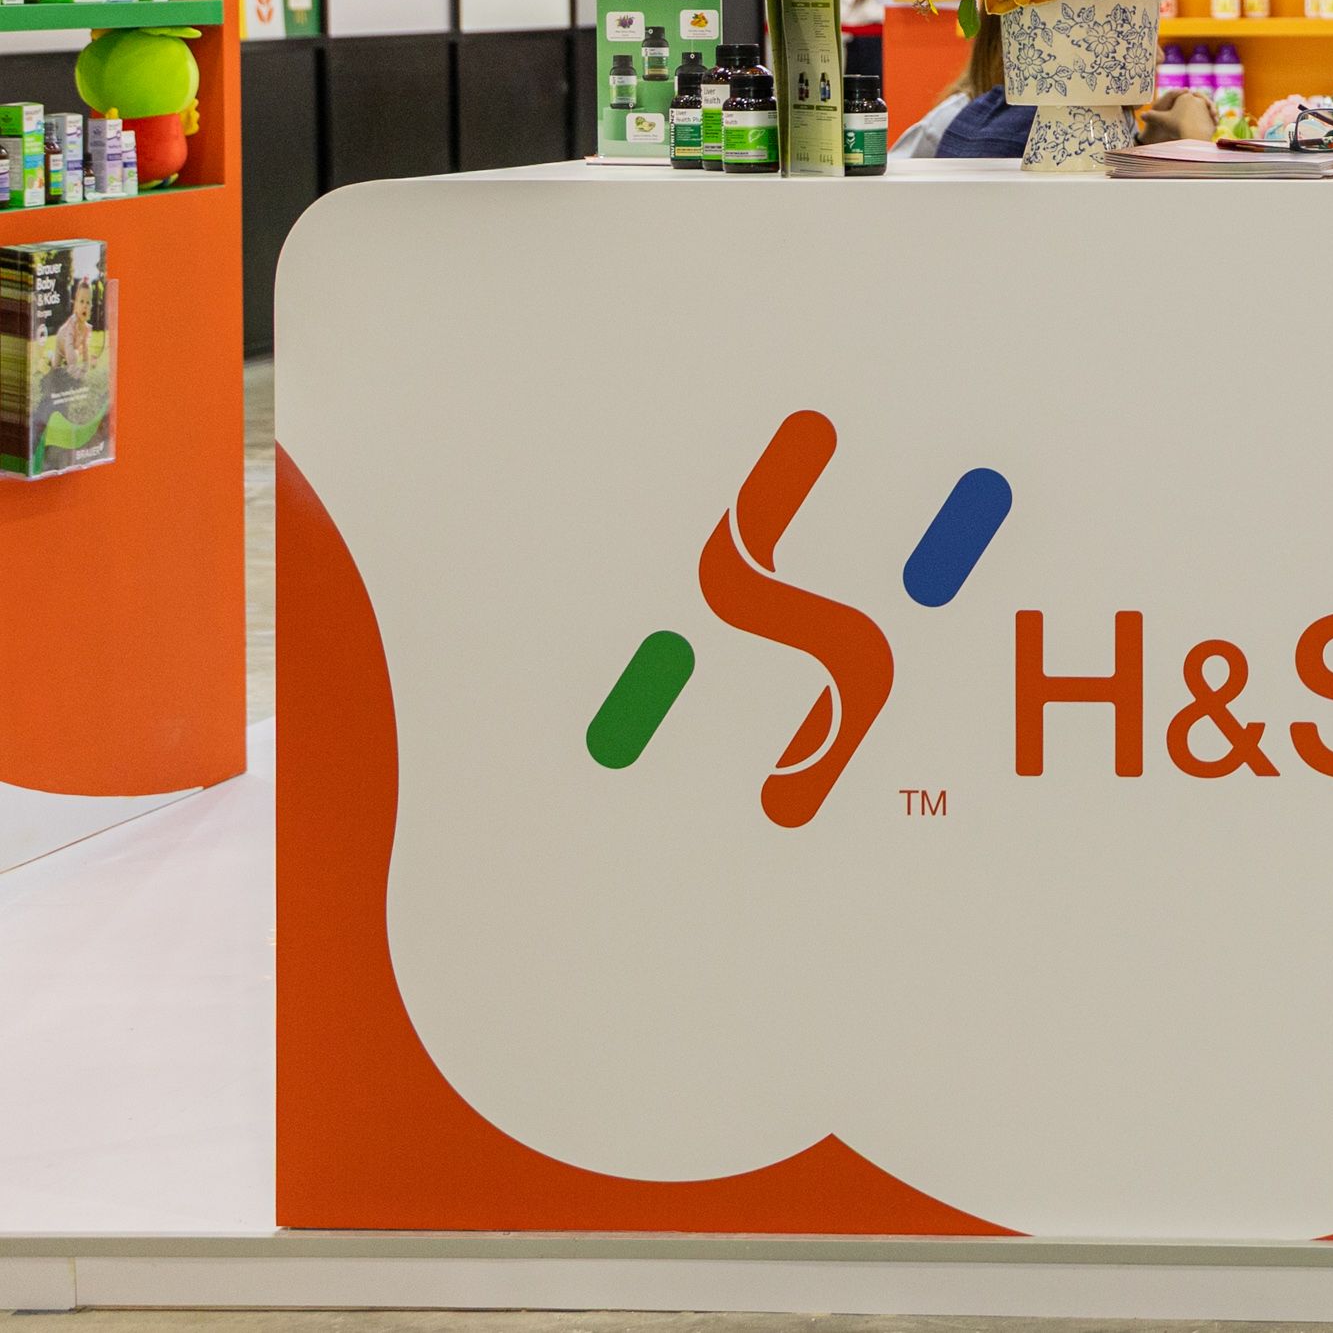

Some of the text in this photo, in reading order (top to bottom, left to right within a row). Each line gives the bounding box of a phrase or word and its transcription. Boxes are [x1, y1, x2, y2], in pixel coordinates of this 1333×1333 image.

[37, 263, 62, 276] Brauer
[36, 276, 56, 292] Baby
[44, 291, 61, 305] Kids
[899, 790, 947, 816] TM
